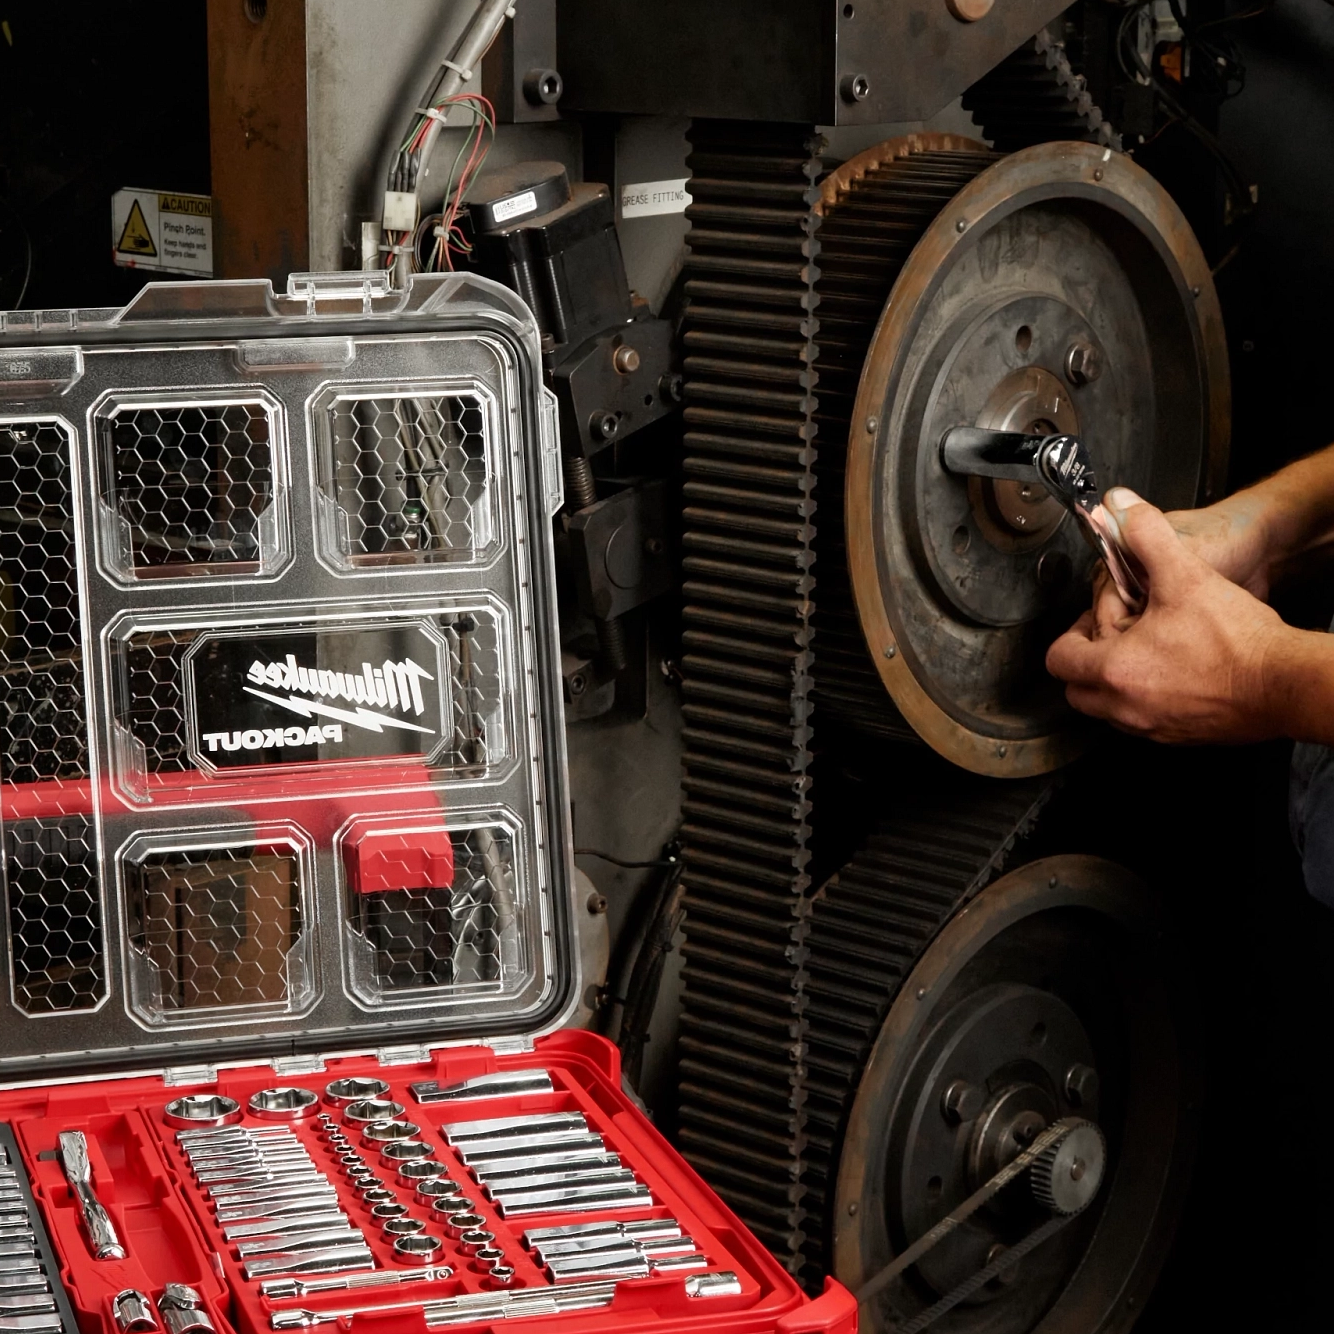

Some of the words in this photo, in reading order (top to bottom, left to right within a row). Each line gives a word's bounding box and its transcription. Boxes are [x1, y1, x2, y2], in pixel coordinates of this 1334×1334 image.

[170, 198, 211, 214] CAUTION
[622, 193, 649, 207] GREASE
[652, 189, 684, 204] FITTING
[163, 222, 184, 234] Pinch
[185, 224, 206, 237] Point.
